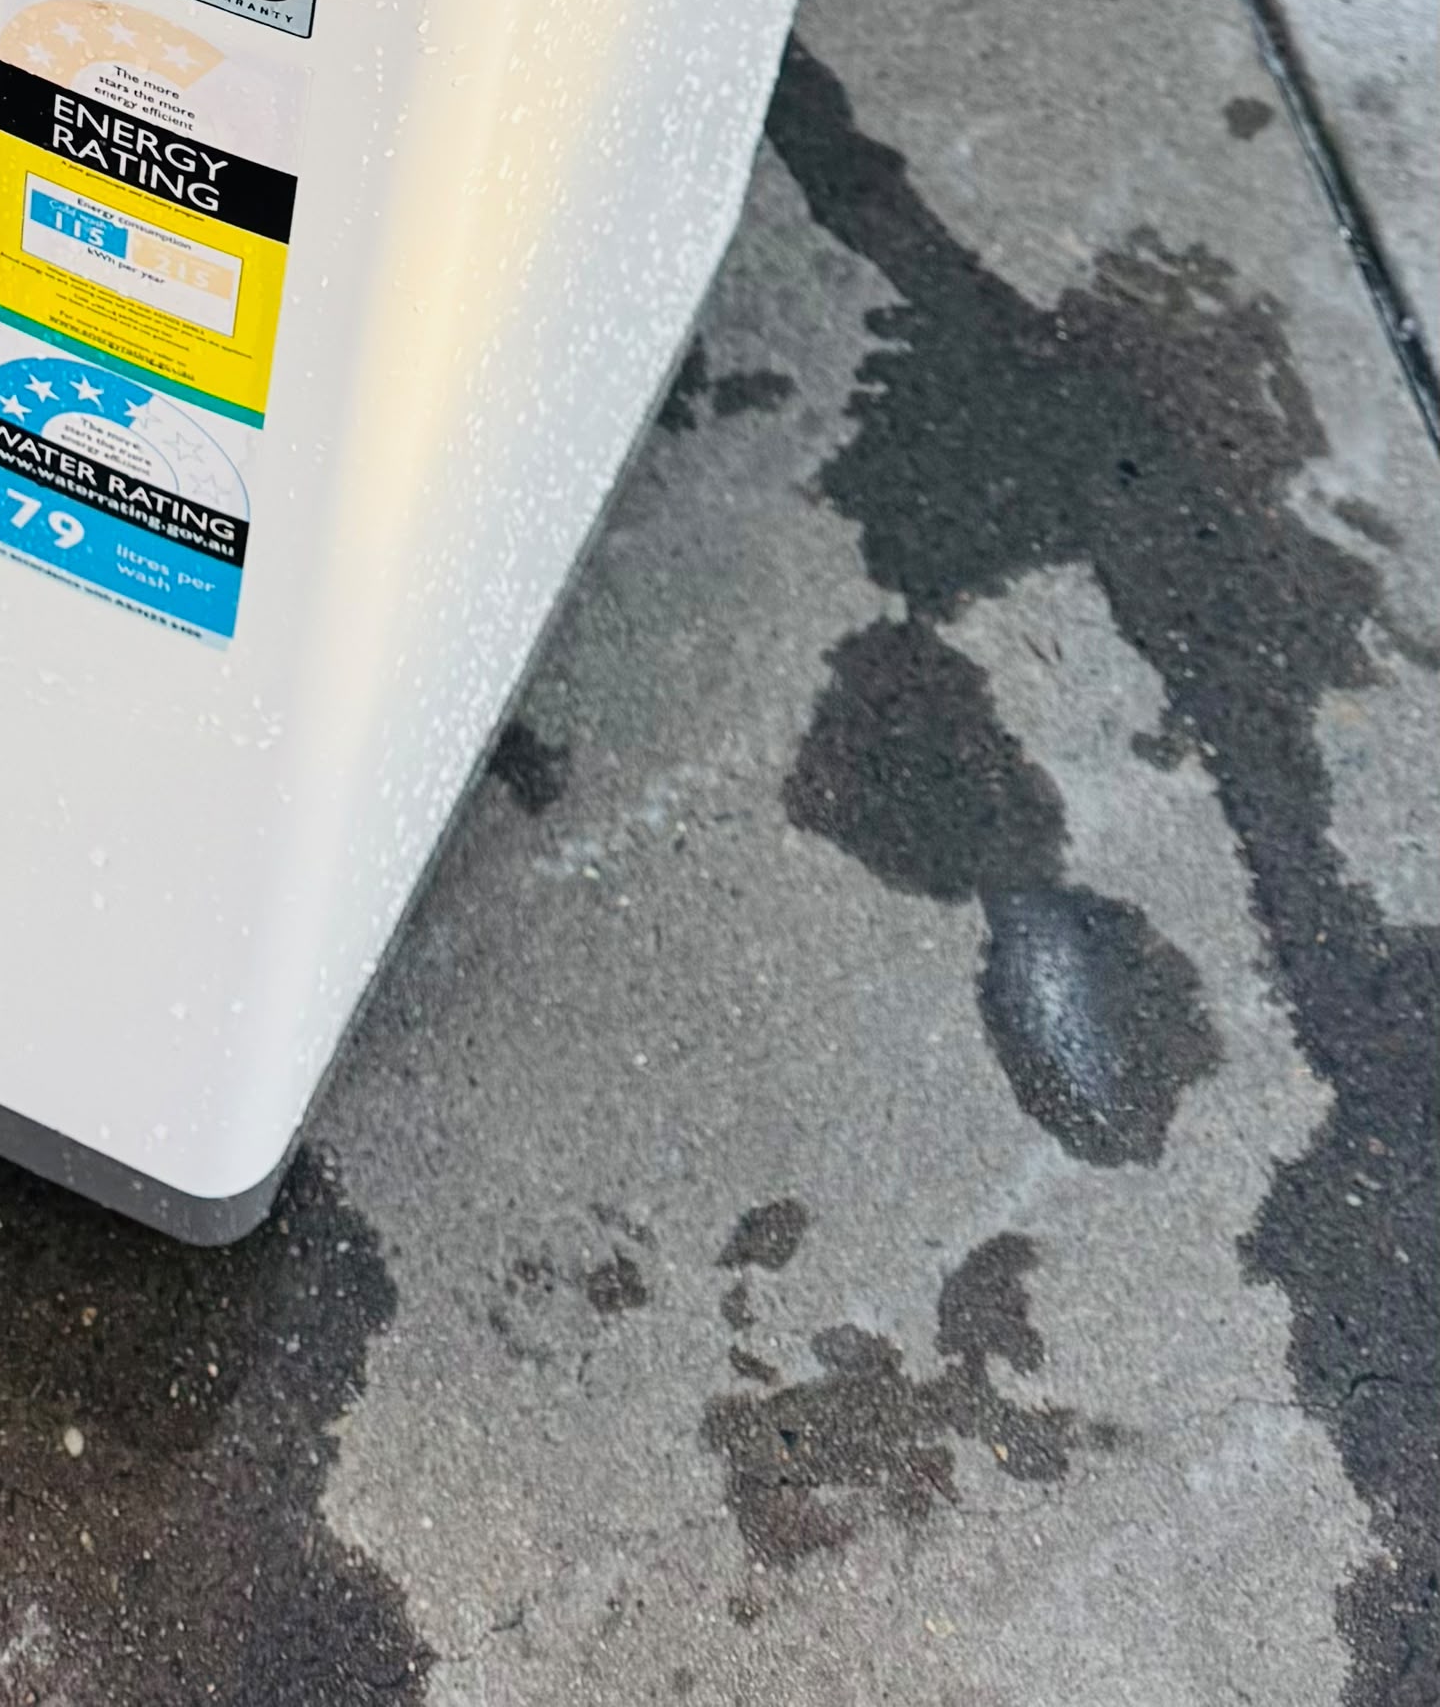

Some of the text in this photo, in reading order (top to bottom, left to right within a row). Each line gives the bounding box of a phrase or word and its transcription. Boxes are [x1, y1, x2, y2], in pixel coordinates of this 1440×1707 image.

[98, 75, 196, 120] stars the more
[113, 65, 180, 100] The more
[94, 86, 194, 132] energy efficient
[53, 93, 230, 183] ENERGY
[52, 124, 221, 213] RATING
[55, 211, 105, 247] 115
[77, 198, 192, 251] Energy consumption
[141, 270, 165, 284] year
[7, 488, 86, 550] 79
[109, 476, 236, 541] RATING
[116, 543, 216, 592] litres per
[116, 562, 171, 593] wash
